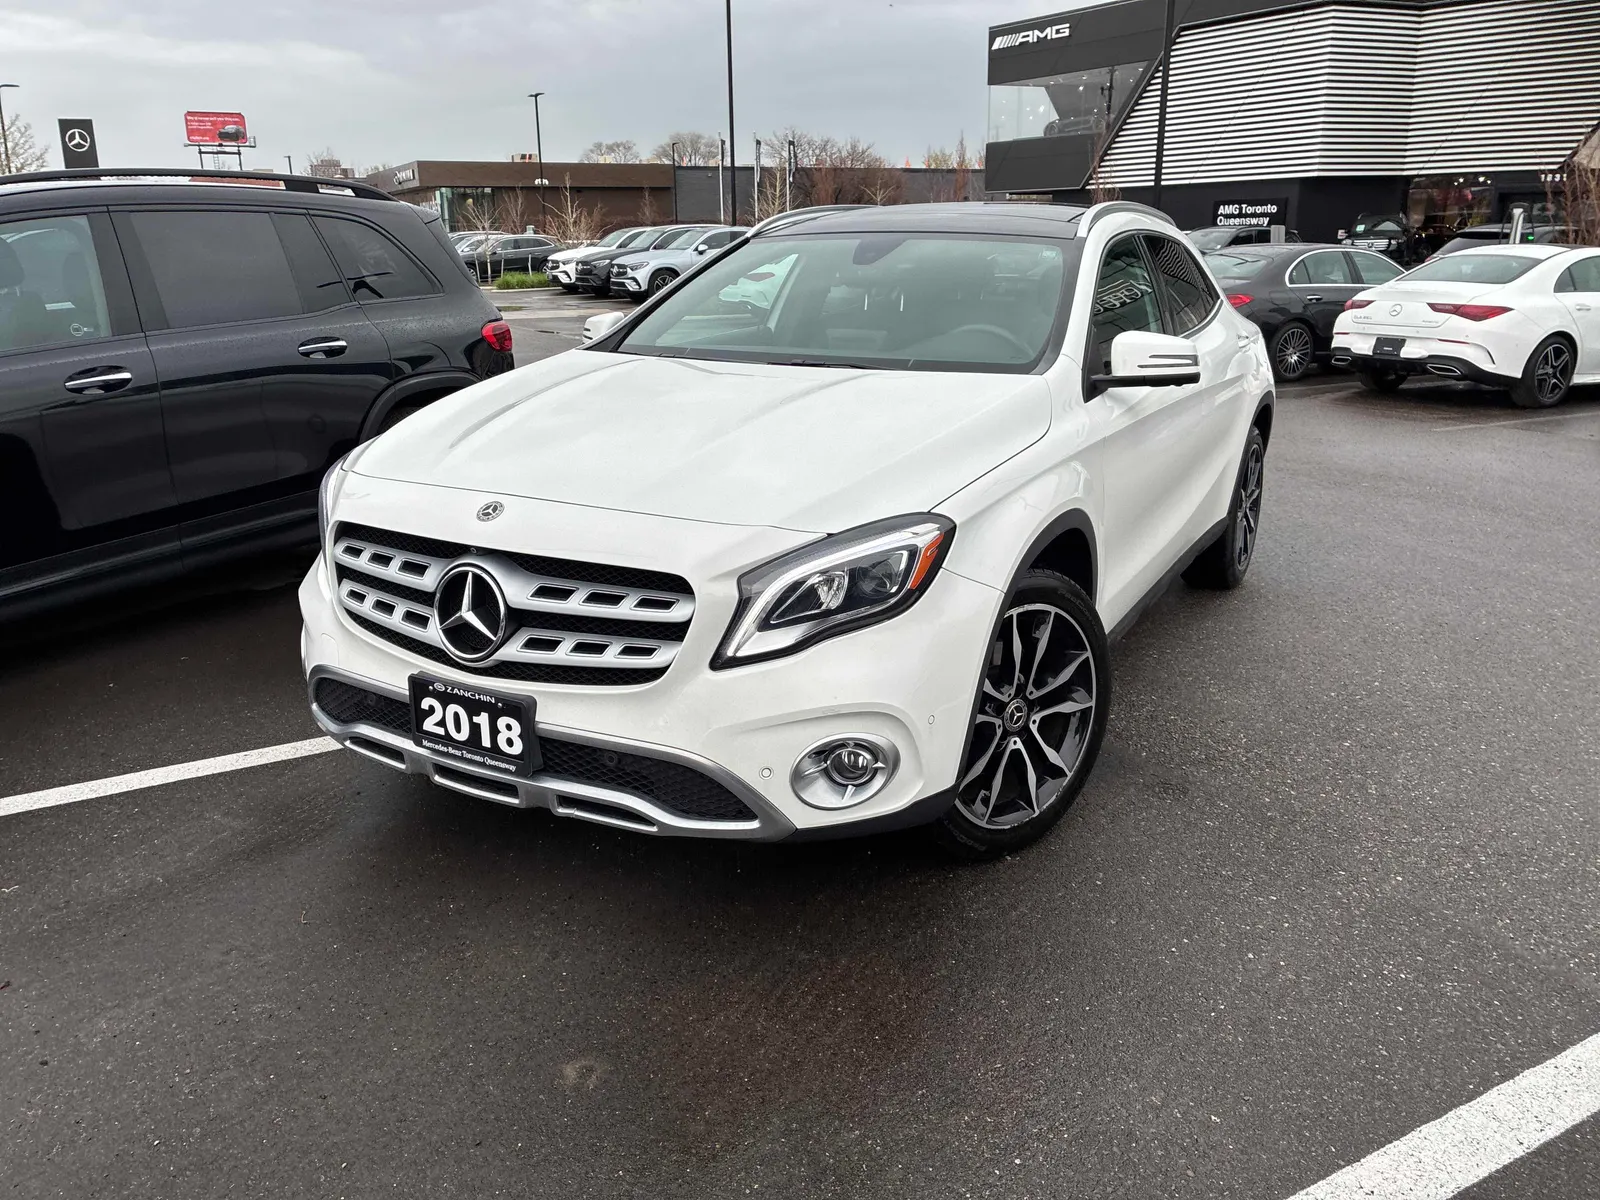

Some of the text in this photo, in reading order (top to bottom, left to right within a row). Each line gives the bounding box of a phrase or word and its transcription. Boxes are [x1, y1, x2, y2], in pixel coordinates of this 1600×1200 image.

[1014, 23, 1070, 46] AMG
[1218, 203, 1278, 215] AMG Toronto
[1217, 216, 1270, 227] Queensway
[446, 686, 495, 703] ZANCHIN
[420, 696, 524, 756] 2018
[422, 739, 517, 773] Mercedes-Benz Toronto Queensway
